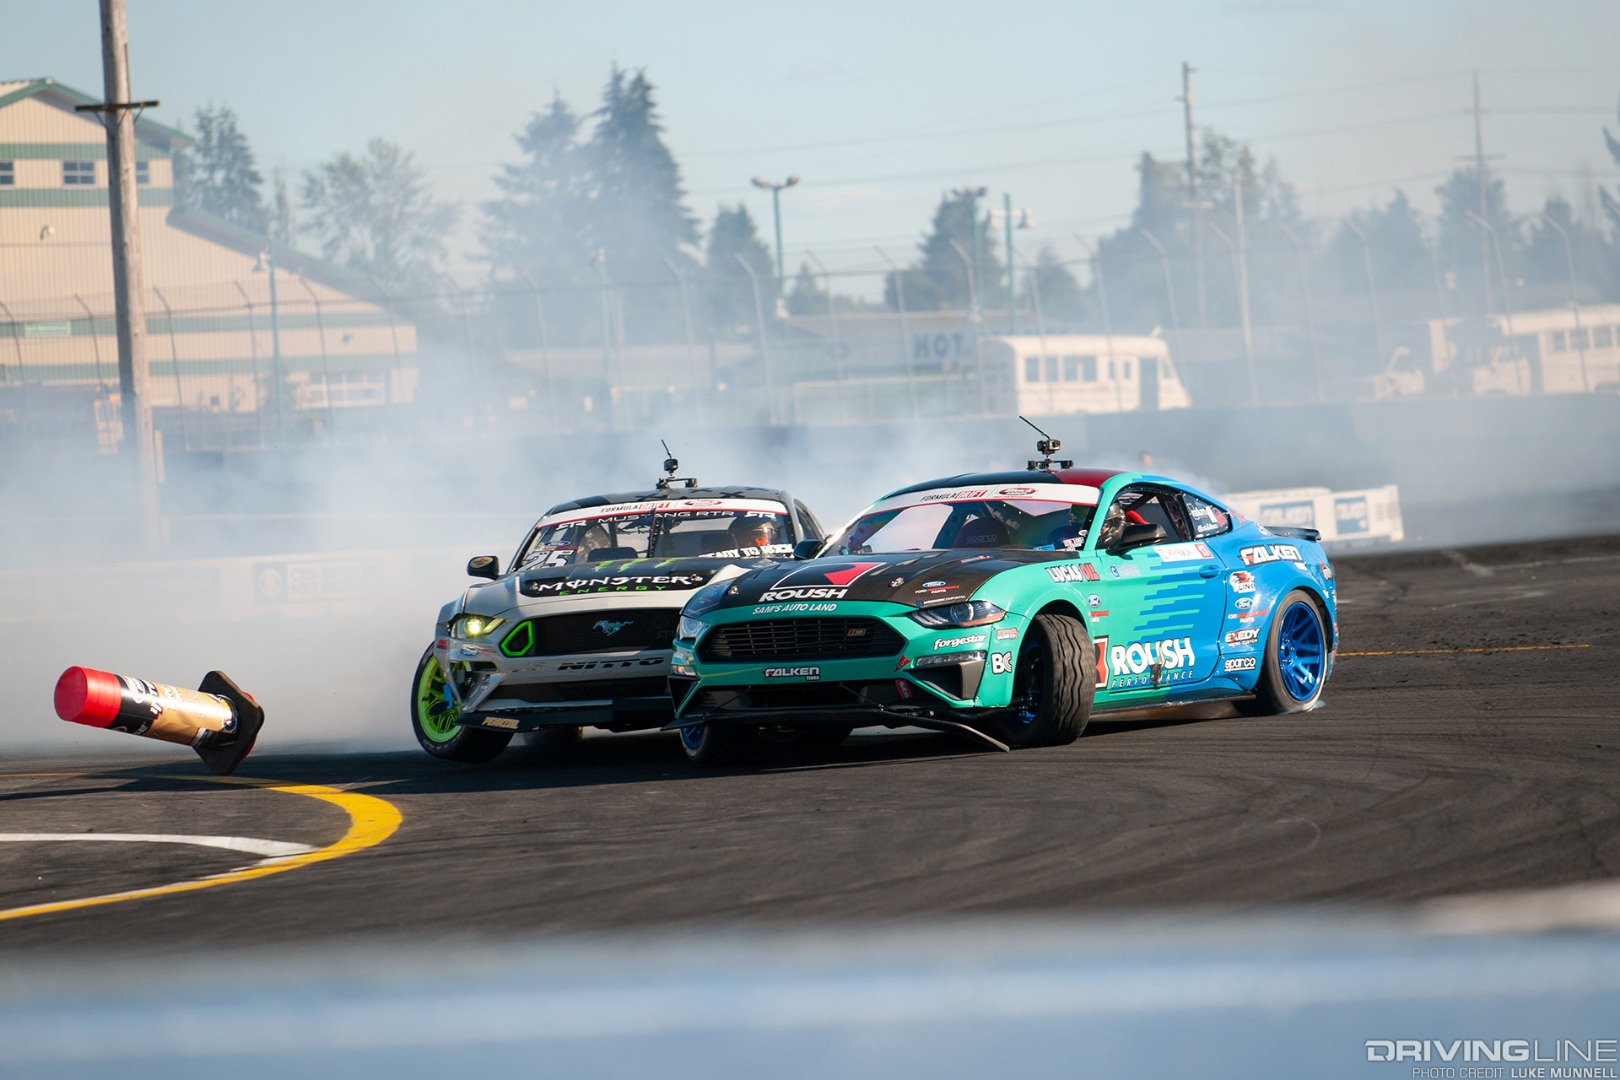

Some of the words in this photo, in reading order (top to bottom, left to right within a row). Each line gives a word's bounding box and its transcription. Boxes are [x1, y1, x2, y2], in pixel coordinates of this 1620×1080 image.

[920, 493, 957, 502] FORMULA
[600, 505, 638, 513] FORMULA
[638, 502, 670, 510] DRIFT
[519, 550, 574, 570] 25
[1240, 544, 1303, 567] FALKEN
[1045, 564, 1083, 583] LUCAS
[1079, 562, 1100, 581] OIL
[538, 576, 694, 592] MONSTER
[559, 585, 667, 597] ENERGY
[758, 589, 848, 602] ROUSH
[752, 605, 782, 615] SAM'S
[781, 604, 809, 612] AUTO
[808, 603, 837, 612] LAND
[933, 635, 988, 650] forgestar
[1224, 628, 1260, 644] EXEDY
[557, 657, 664, 671] NITTO
[1111, 637, 1195, 676] ROUSH
[765, 667, 819, 677] FALKEN
[1224, 657, 1256, 672] sparco
[1111, 670, 1194, 688] PERFOMANCE
